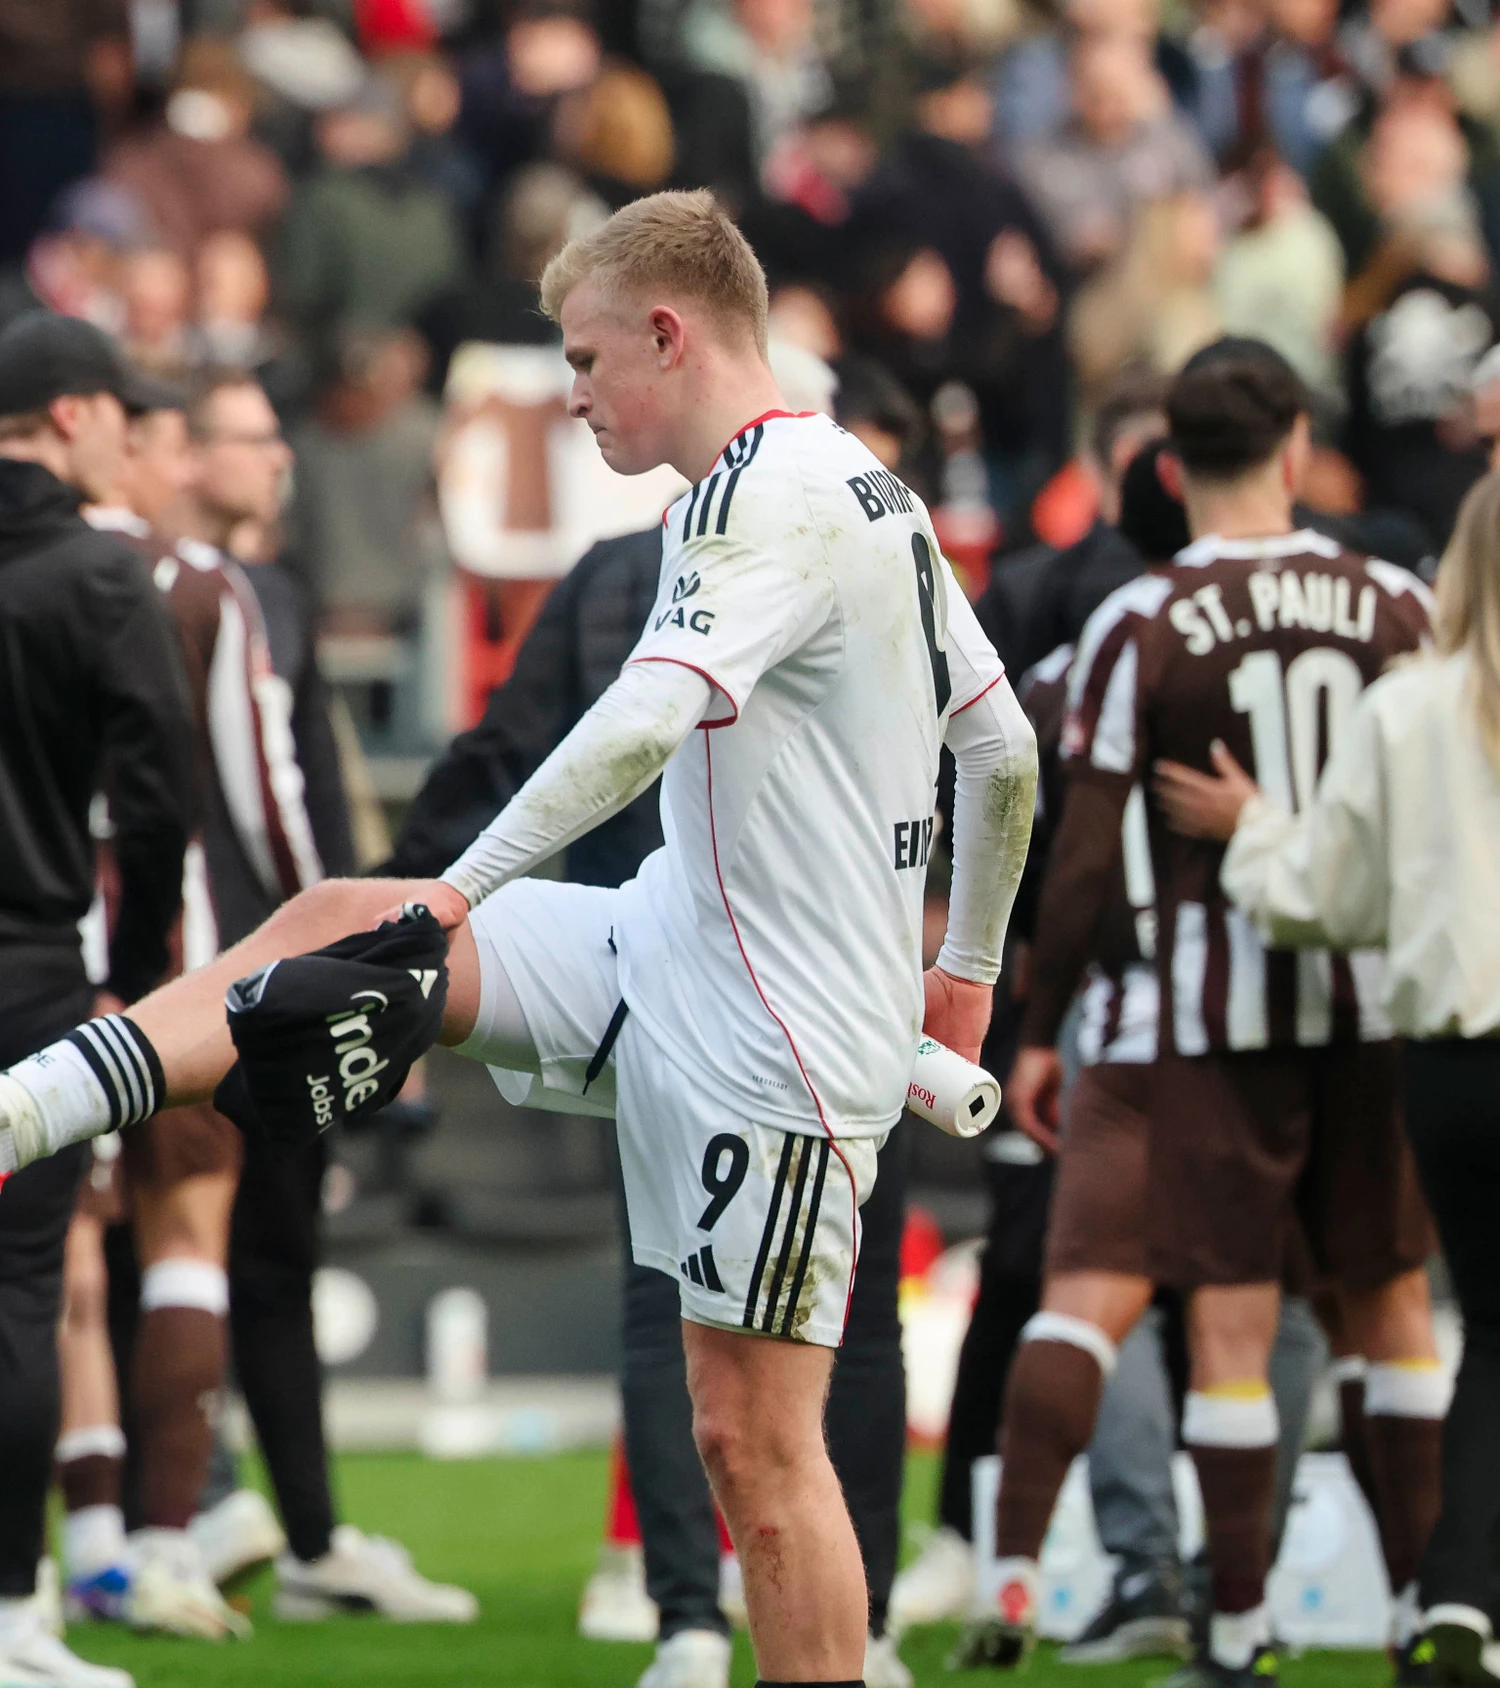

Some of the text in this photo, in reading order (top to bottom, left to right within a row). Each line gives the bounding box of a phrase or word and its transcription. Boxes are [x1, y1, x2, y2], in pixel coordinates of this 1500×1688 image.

[1169, 569, 1377, 656] ST. PAULI
[1227, 648, 1364, 815] 10
[306, 1073, 336, 1126] Jobs
[696, 1132, 750, 1232] 9
